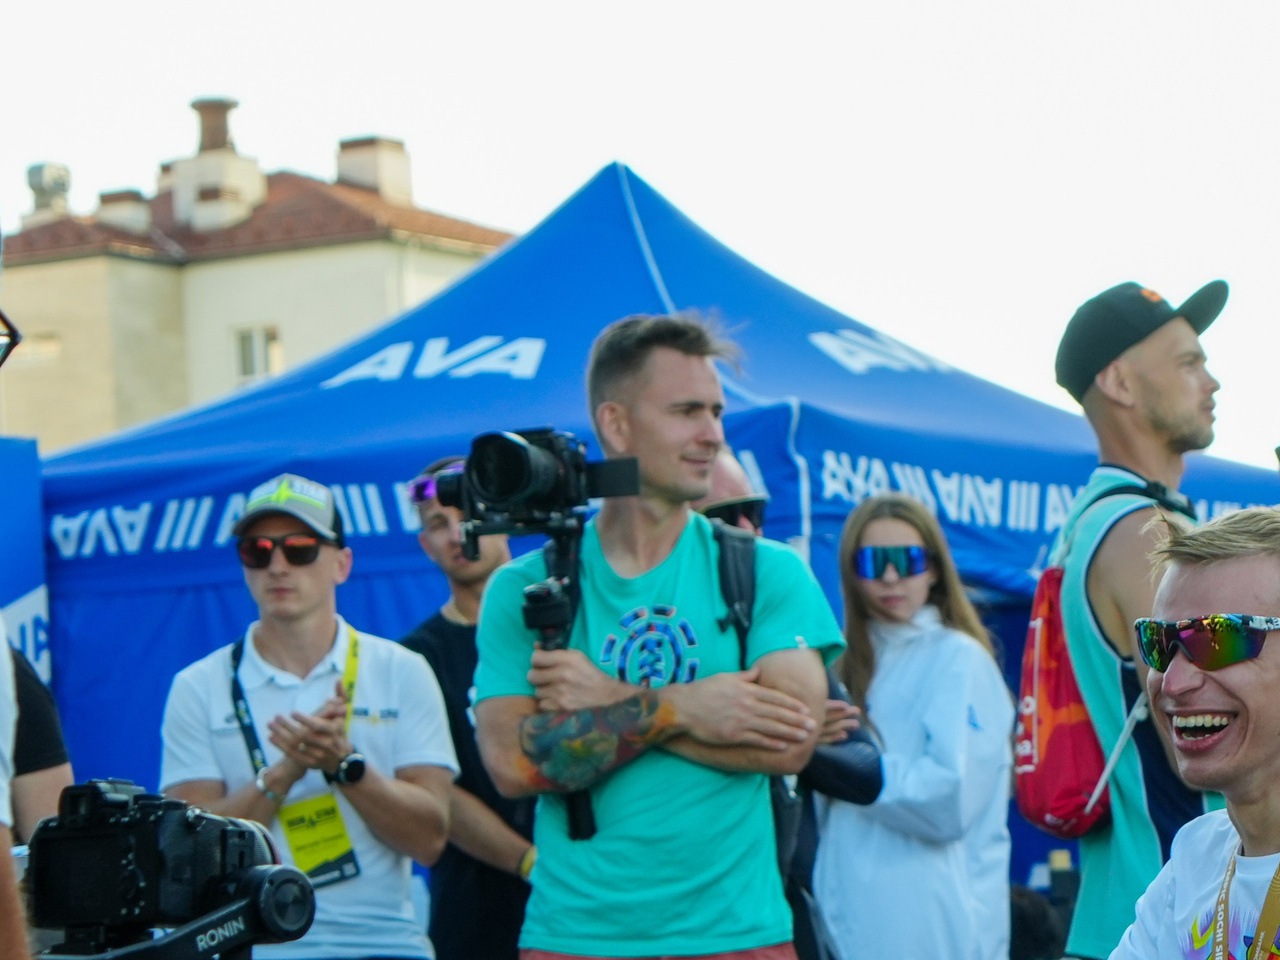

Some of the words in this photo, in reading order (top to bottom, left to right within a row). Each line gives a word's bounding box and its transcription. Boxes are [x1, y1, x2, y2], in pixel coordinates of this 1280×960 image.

[320, 335, 547, 390] AVA
[196, 915, 246, 951] RONIN
[1215, 904, 1225, 942] SOCHI
